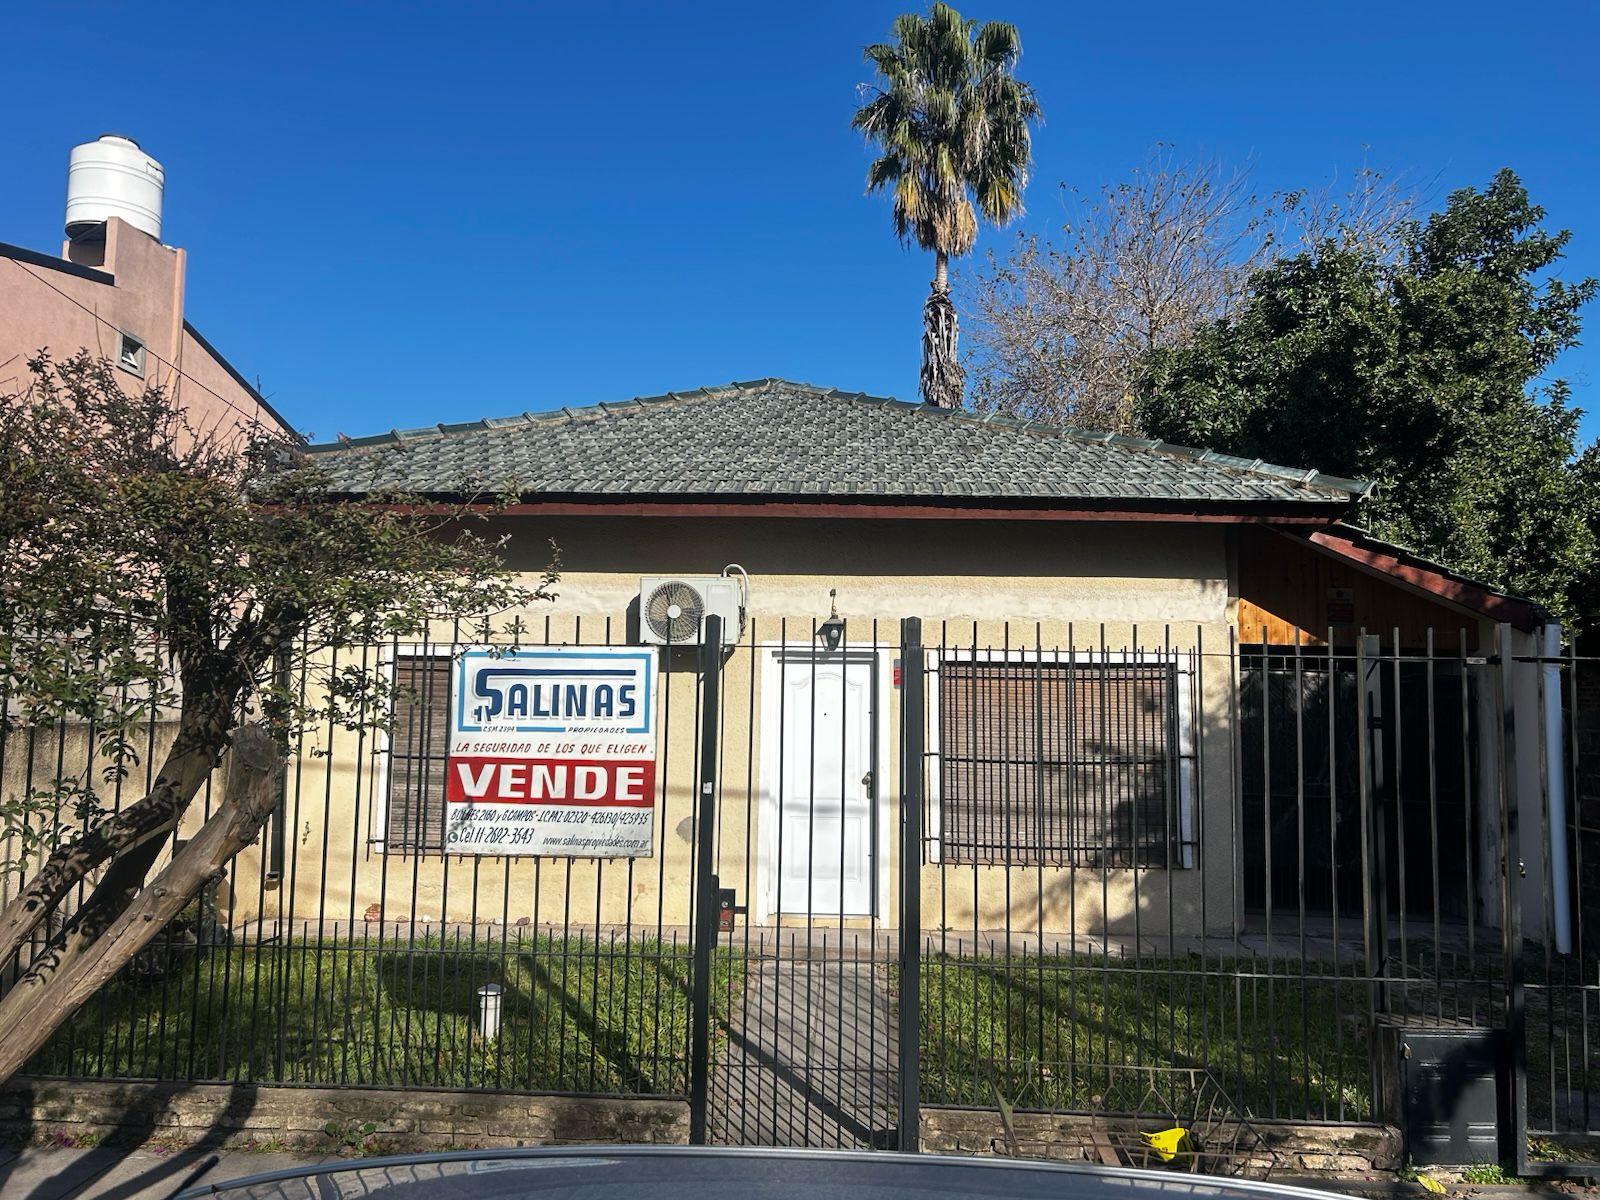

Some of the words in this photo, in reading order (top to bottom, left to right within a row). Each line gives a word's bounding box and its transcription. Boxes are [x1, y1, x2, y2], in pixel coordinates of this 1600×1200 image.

[473, 668, 637, 721] SALINAS
[455, 742, 470, 753] LA
[473, 743, 532, 753] SEGURIDAD
[537, 743, 551, 753] DE
[555, 743, 576, 754] LOS
[580, 744, 603, 755] QUE
[606, 744, 648, 754] ELIGEN
[456, 763, 645, 801] VENDE
[542, 834, 649, 850] www.salinaspropiedades.com.ar
